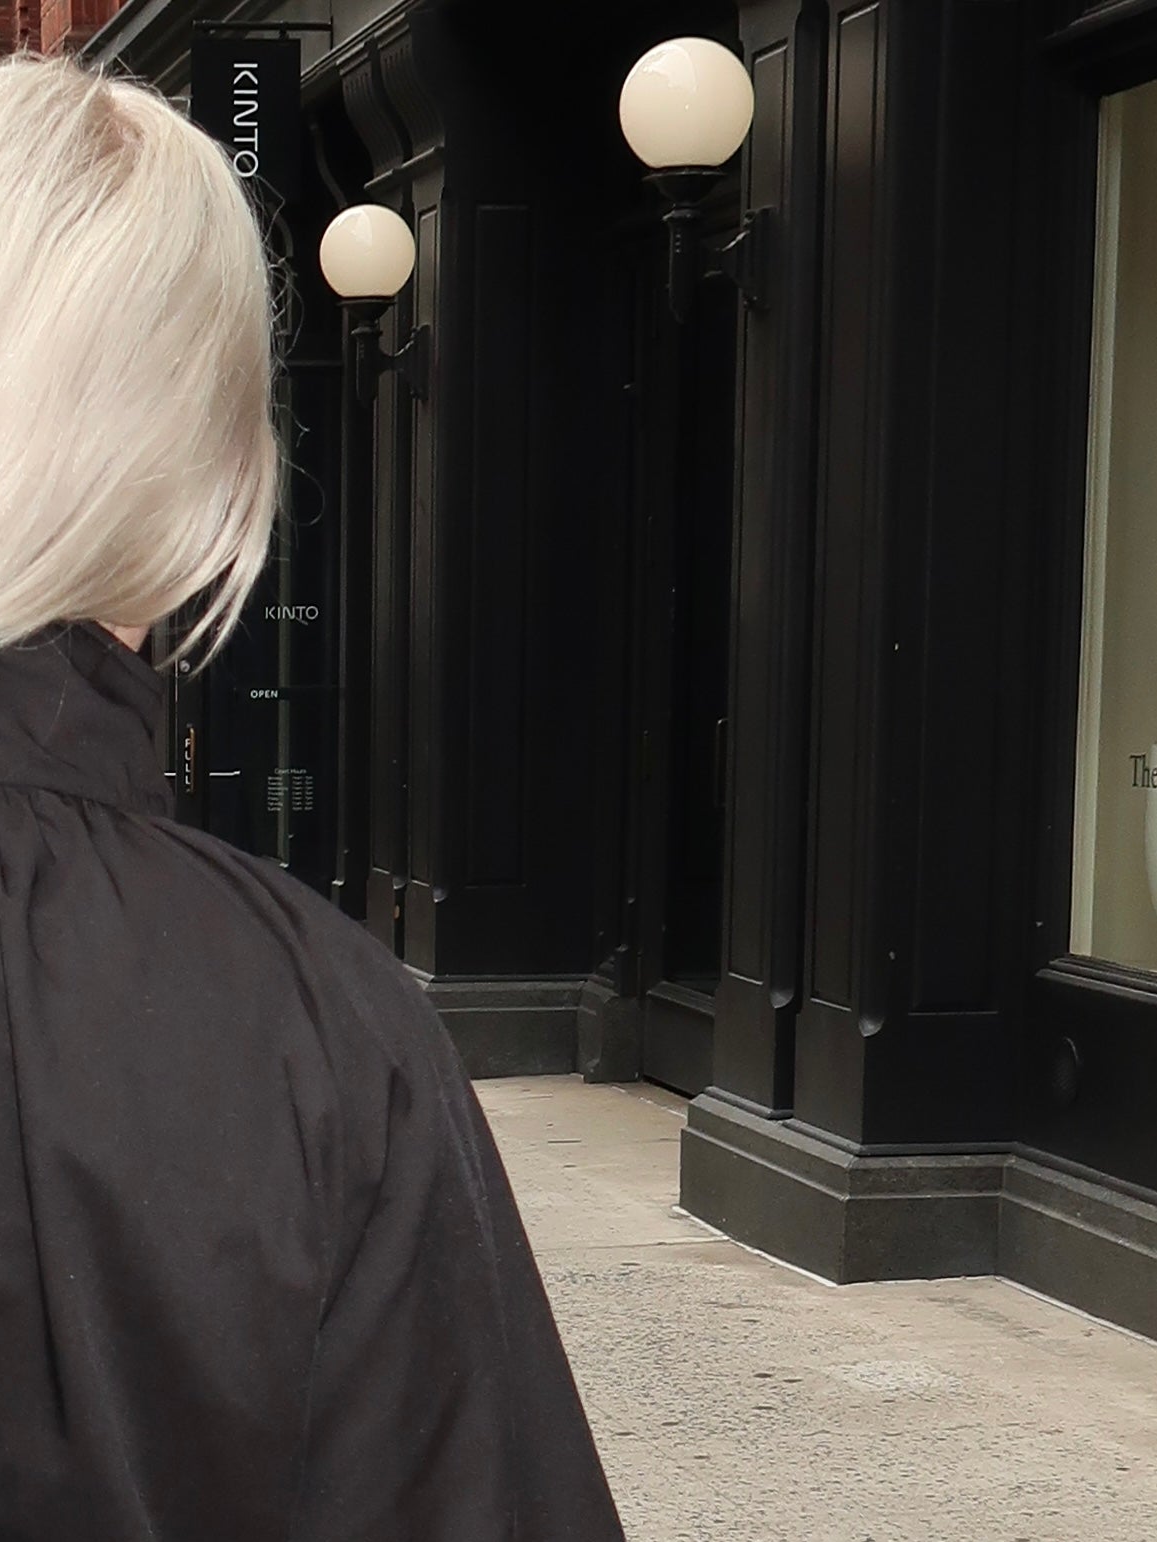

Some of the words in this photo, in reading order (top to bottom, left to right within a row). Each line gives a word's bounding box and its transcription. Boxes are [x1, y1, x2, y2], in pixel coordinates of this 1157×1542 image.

[233, 63, 259, 177] KINTO
[265, 606, 319, 620] KINTO
[250, 690, 278, 699] OPEN
